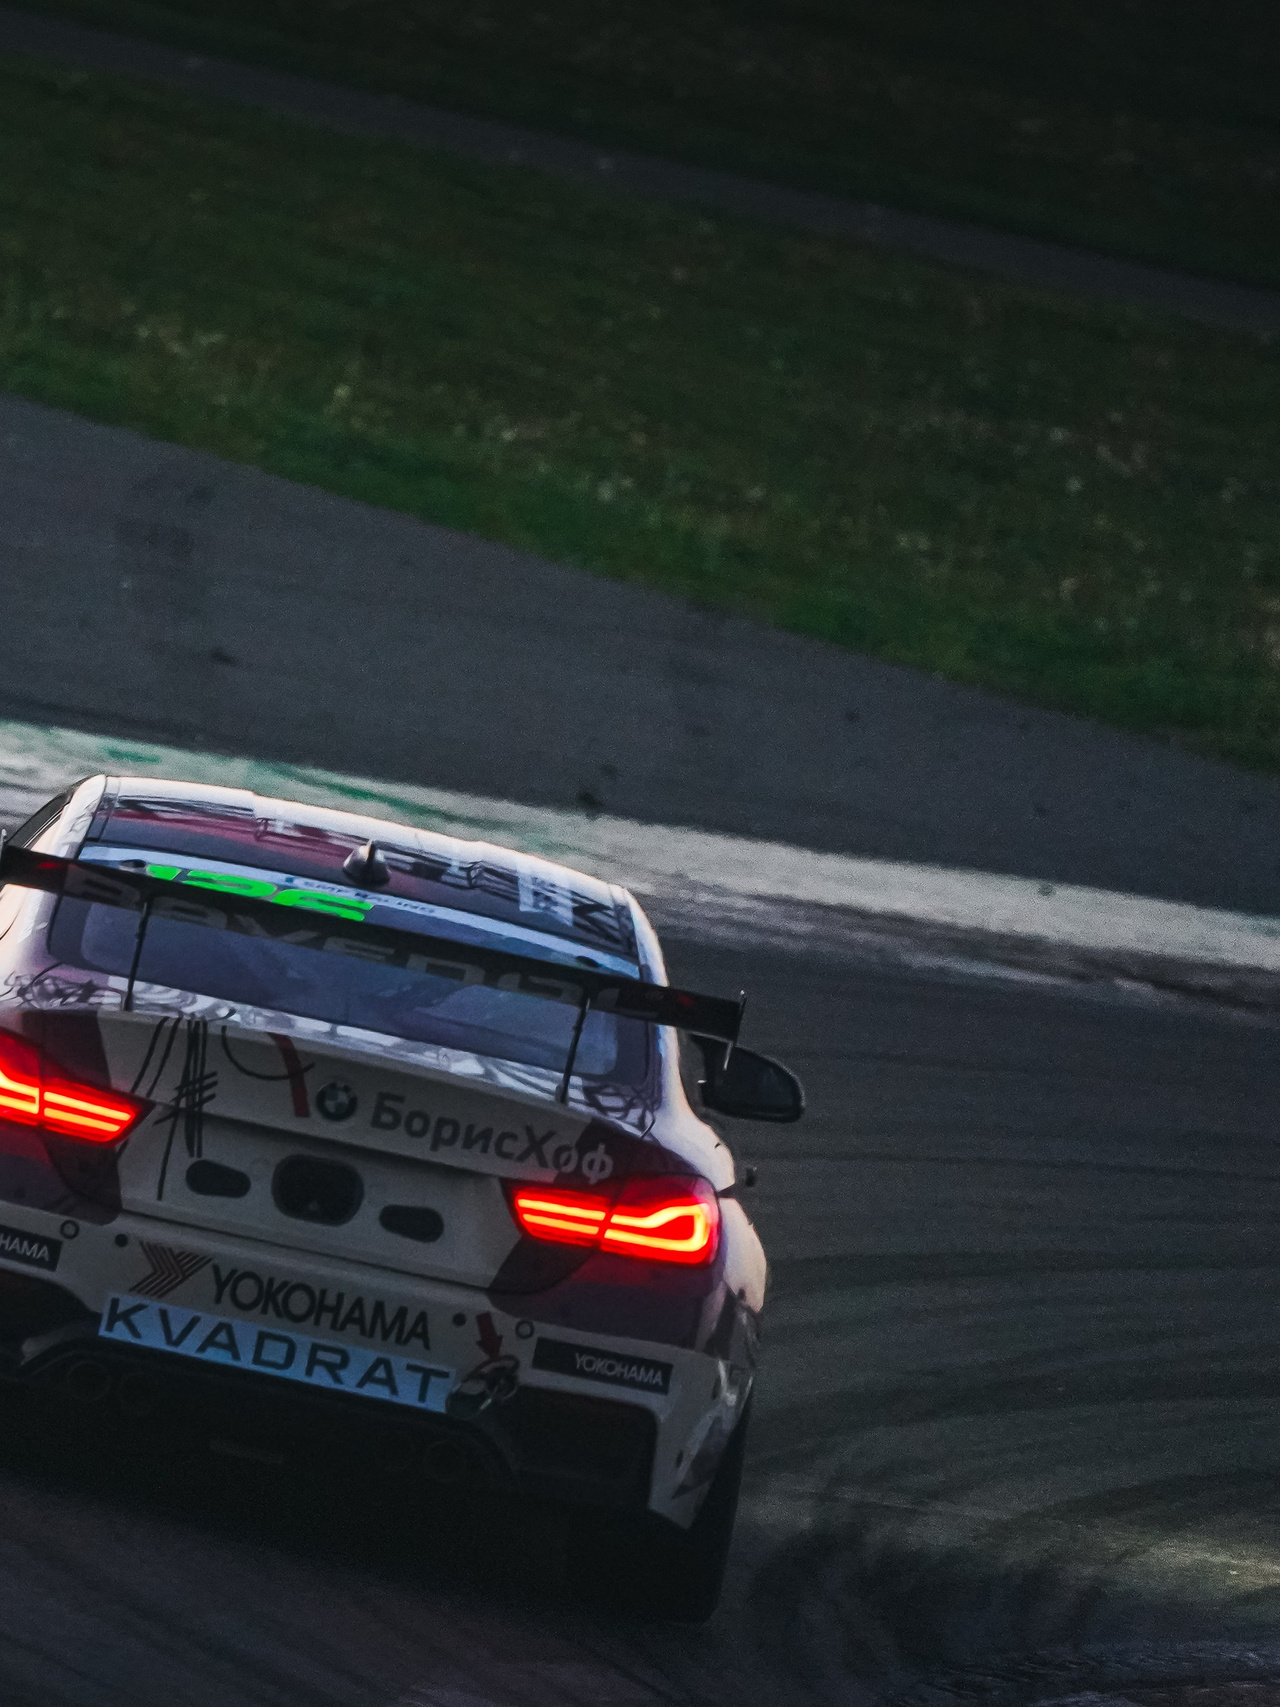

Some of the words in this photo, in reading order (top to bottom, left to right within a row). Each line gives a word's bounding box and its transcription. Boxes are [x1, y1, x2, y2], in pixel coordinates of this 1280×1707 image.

[370, 1091, 615, 1185] БорисХоф
[103, 1297, 451, 1404] KVADRAT
[211, 1263, 431, 1351] YOKOHAMA
[574, 1352, 664, 1386] YOKOHAMA
